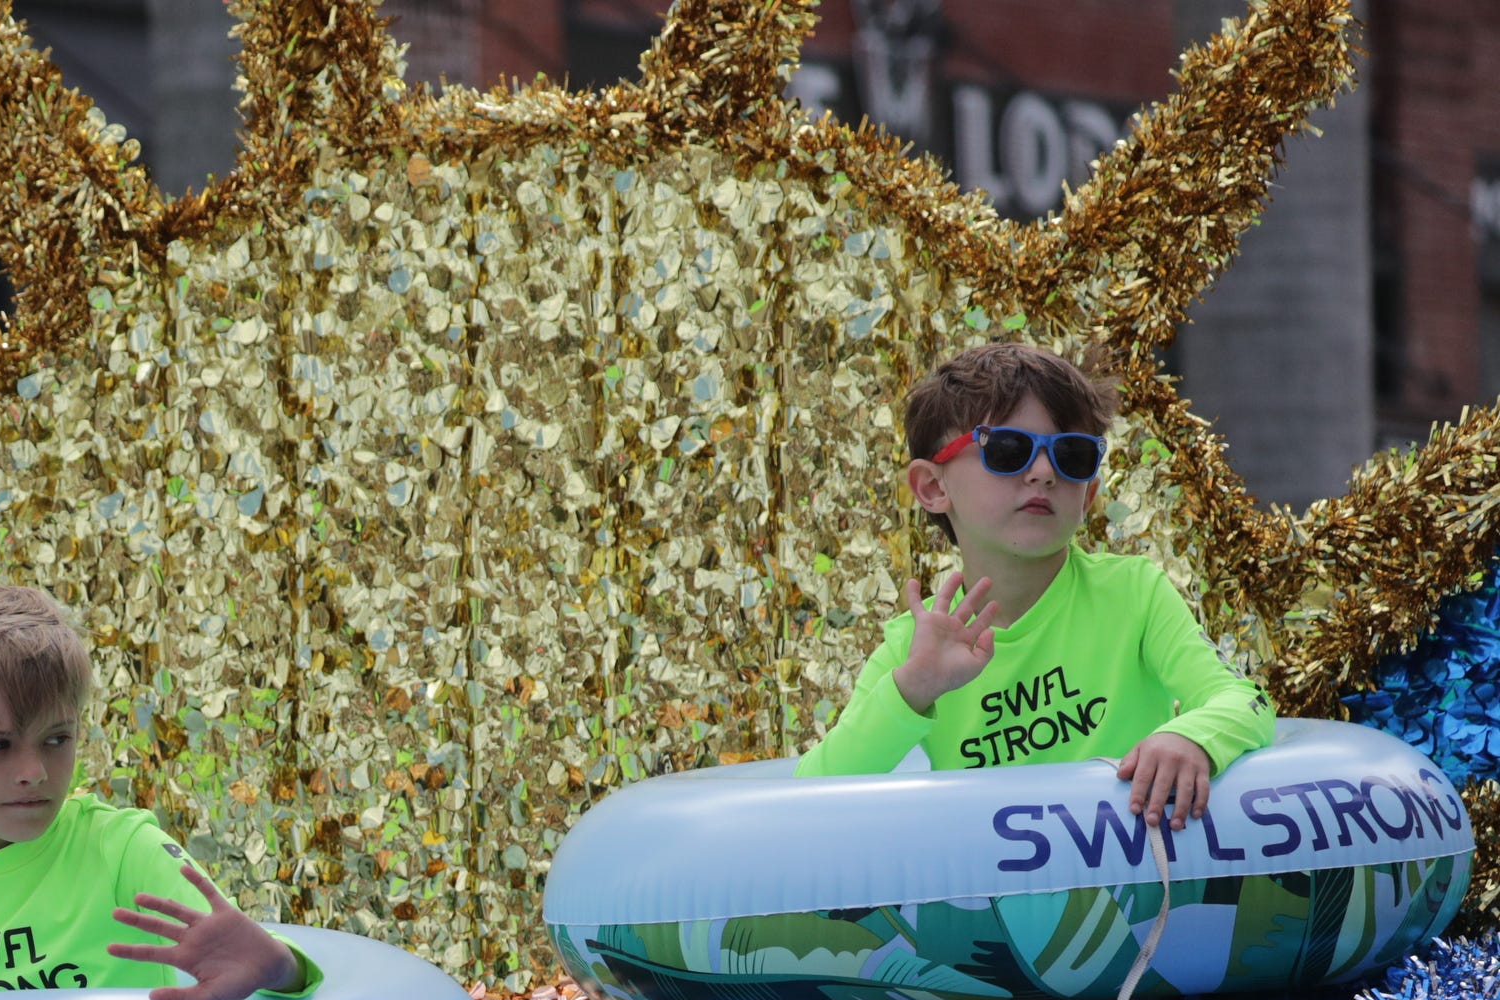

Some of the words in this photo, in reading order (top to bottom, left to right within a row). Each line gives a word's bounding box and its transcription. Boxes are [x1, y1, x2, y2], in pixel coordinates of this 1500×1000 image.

[981, 666, 1080, 726] SWFL
[993, 795, 1245, 872] SWFL
[1240, 768, 1462, 860] STRONG
